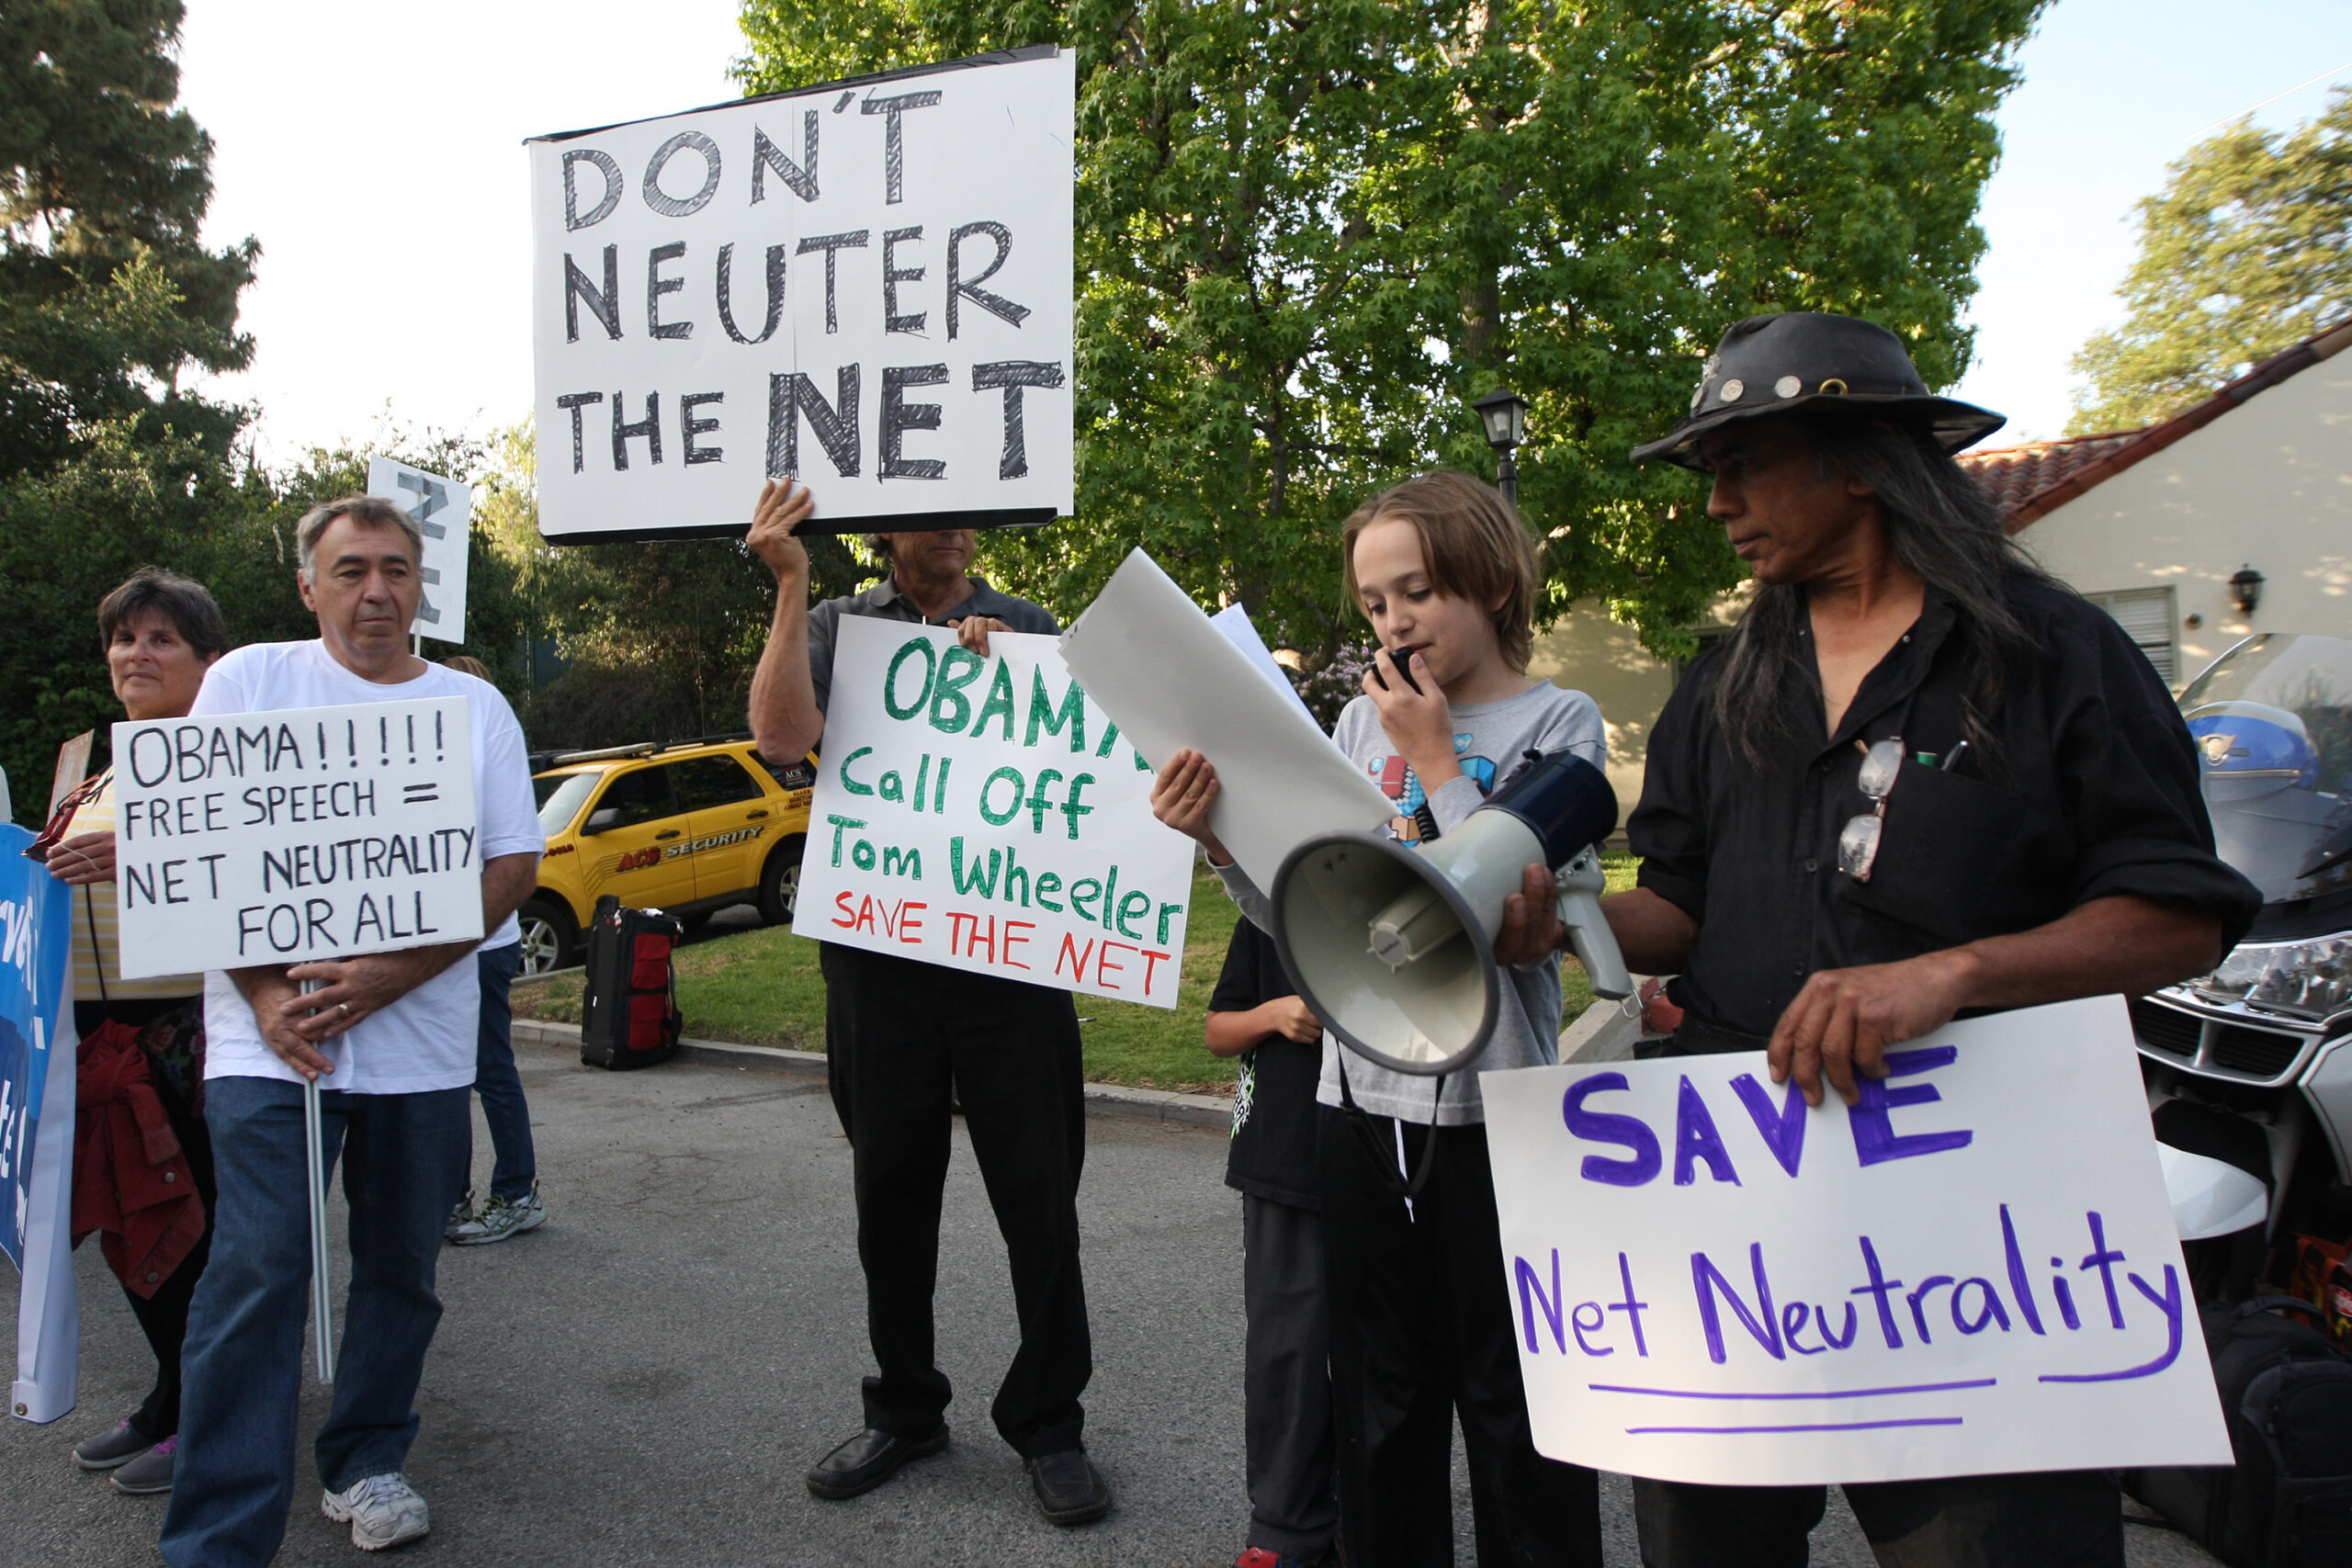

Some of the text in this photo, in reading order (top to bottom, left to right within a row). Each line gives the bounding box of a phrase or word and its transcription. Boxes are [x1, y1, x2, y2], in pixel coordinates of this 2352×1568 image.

[562, 89, 943, 232] DON'T
[563, 220, 1032, 344] NEUTER
[557, 361, 1066, 484] THE NET
[125, 792, 229, 840] FREE
[243, 779, 377, 825] SPEECH
[616, 826, 764, 873] ACS SECURITY
[840, 746, 1096, 840] Call Off
[126, 826, 476, 909] NET NEUTRALITY
[238, 890, 438, 956] FOR ALL
[827, 814, 1183, 946] Tom Wheeler
[831, 890, 1172, 998] SAVE THE NET
[1563, 1044, 1974, 1188] SAVE
[1514, 1203, 2185, 1383] Net Neutrality
